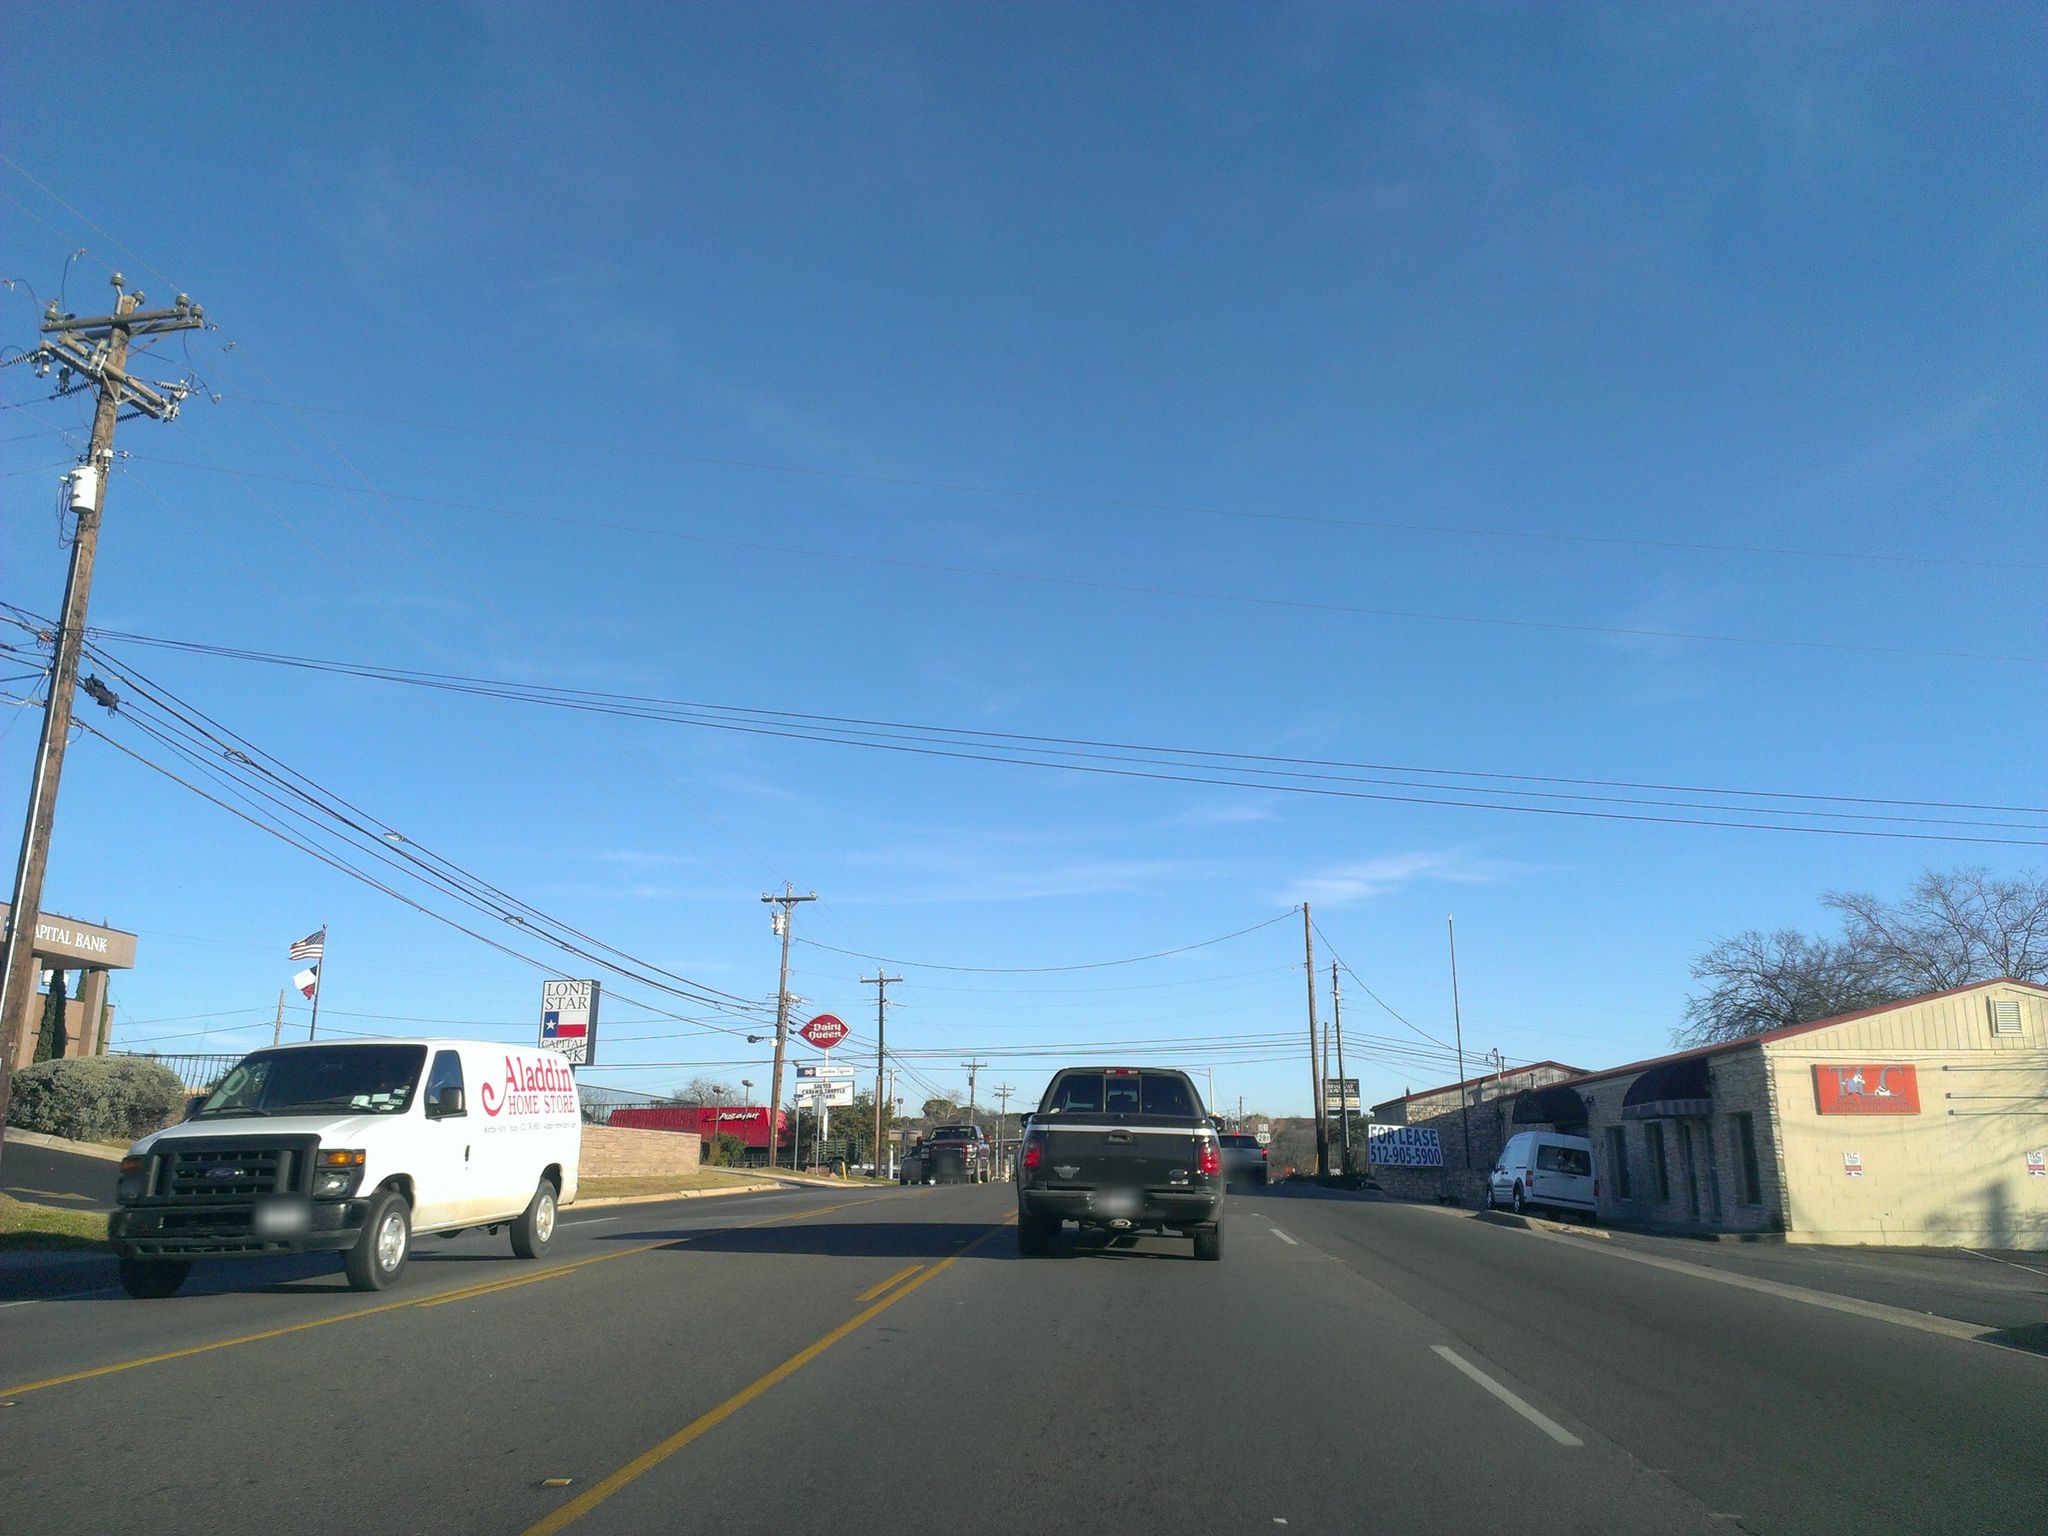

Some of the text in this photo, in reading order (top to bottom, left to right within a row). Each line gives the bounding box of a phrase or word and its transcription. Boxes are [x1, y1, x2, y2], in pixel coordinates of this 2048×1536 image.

[35, 923, 108, 954] APITAL BANK
[547, 982, 590, 997] LONE
[545, 997, 588, 1010] STAR
[813, 1022, 842, 1032] Dairy
[541, 1040, 586, 1049] CAPITAL
[808, 1031, 843, 1041] Queen
[481, 1055, 573, 1117] Aladdin
[1828, 1065, 1905, 1097] TLC
[508, 1094, 576, 1115] HOME STORE
[1258, 1133, 1270, 1143] 281
[1370, 1126, 1439, 1147] FOR LEASE
[1370, 1145, 1441, 1165] 512-905-5900
